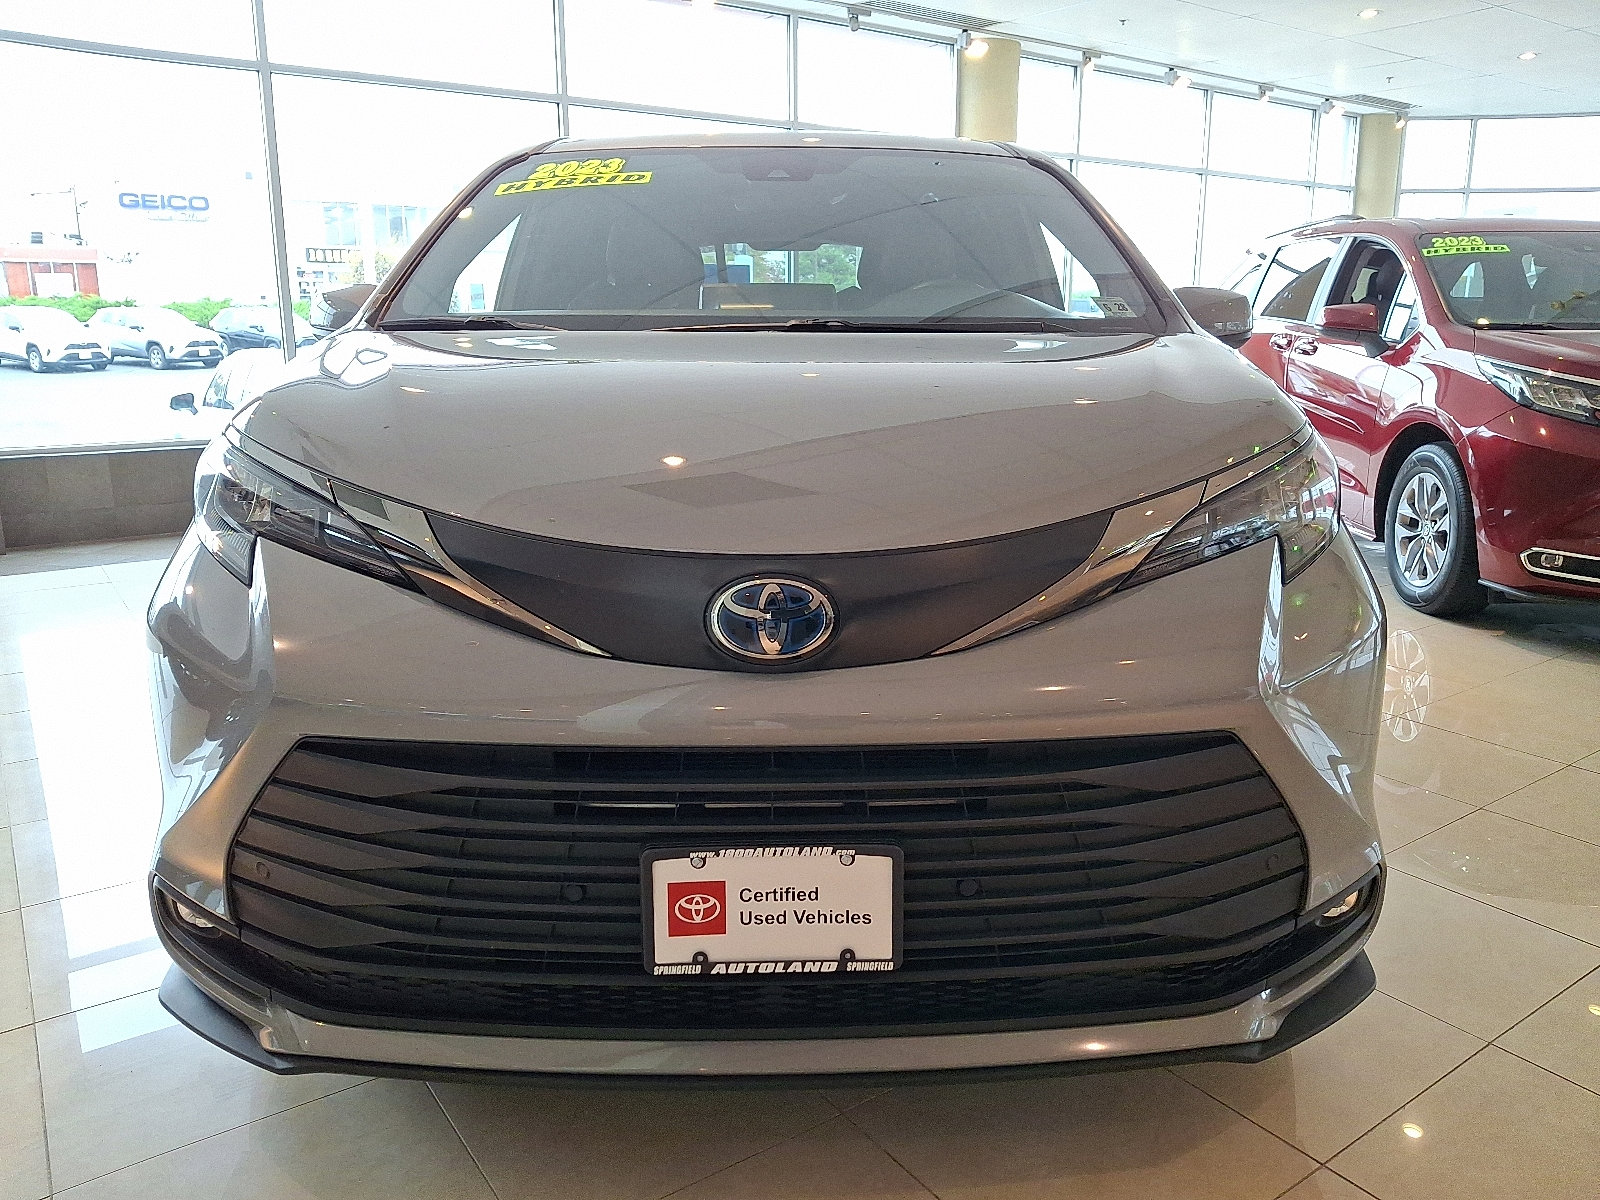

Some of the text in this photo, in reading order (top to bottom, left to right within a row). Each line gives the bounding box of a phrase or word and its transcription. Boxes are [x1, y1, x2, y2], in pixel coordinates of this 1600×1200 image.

[528, 157, 626, 180] 2023
[501, 174, 646, 193] HYBRID
[118, 192, 210, 211] GEICO
[1426, 245, 1508, 255] HYBRID
[1431, 235, 1487, 248] 2023
[739, 886, 819, 903] Certified
[739, 909, 872, 926] Used Vehicles
[653, 961, 894, 976] SPRINGFIELD AUTOLAND SPRINGFIELD
